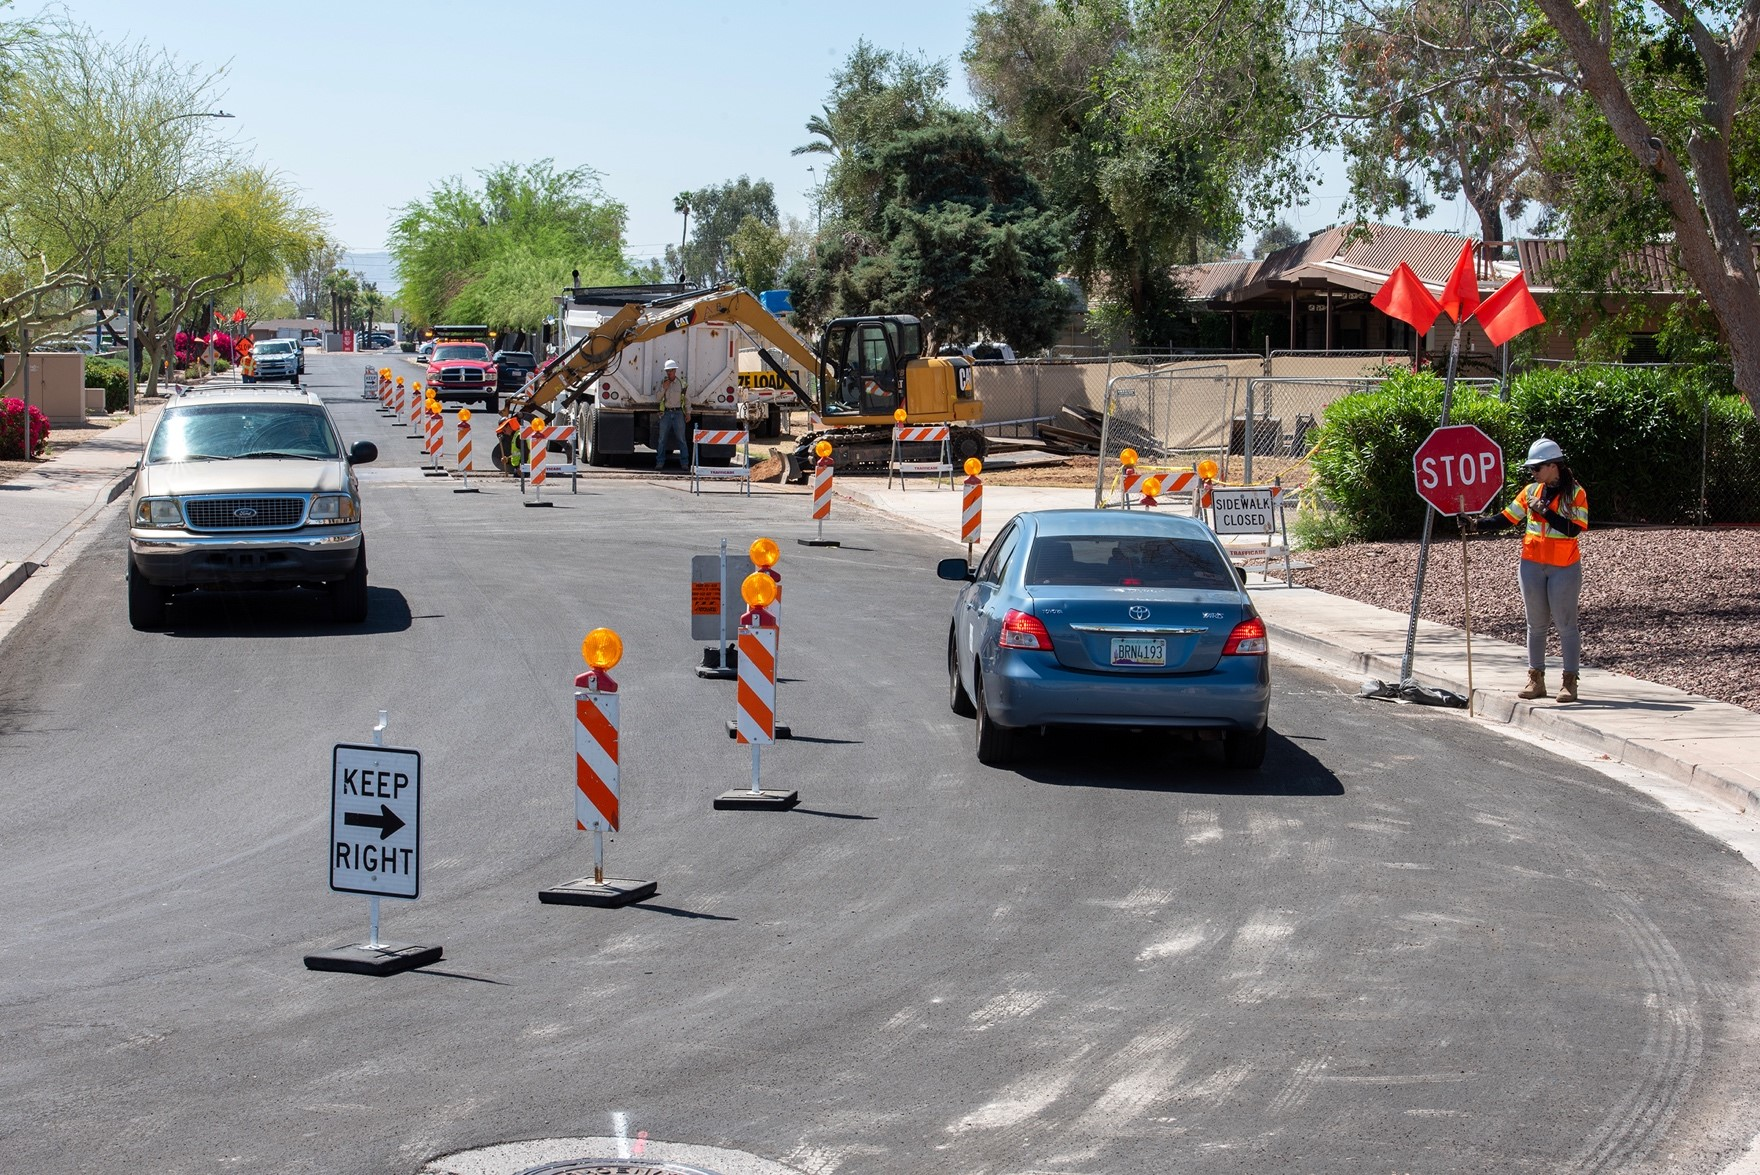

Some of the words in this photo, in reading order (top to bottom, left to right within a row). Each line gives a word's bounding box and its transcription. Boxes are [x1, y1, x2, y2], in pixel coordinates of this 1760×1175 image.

[674, 315, 690, 328] CAT
[754, 374, 785, 390] LOAD
[1422, 452, 1496, 489] STOP
[1216, 498, 1271, 510] SIDEWALK
[1223, 514, 1265, 526] CLOSED
[1118, 645, 1163, 659] BRN4193
[343, 768, 409, 799] KEEP
[336, 842, 413, 875] RIGHT
